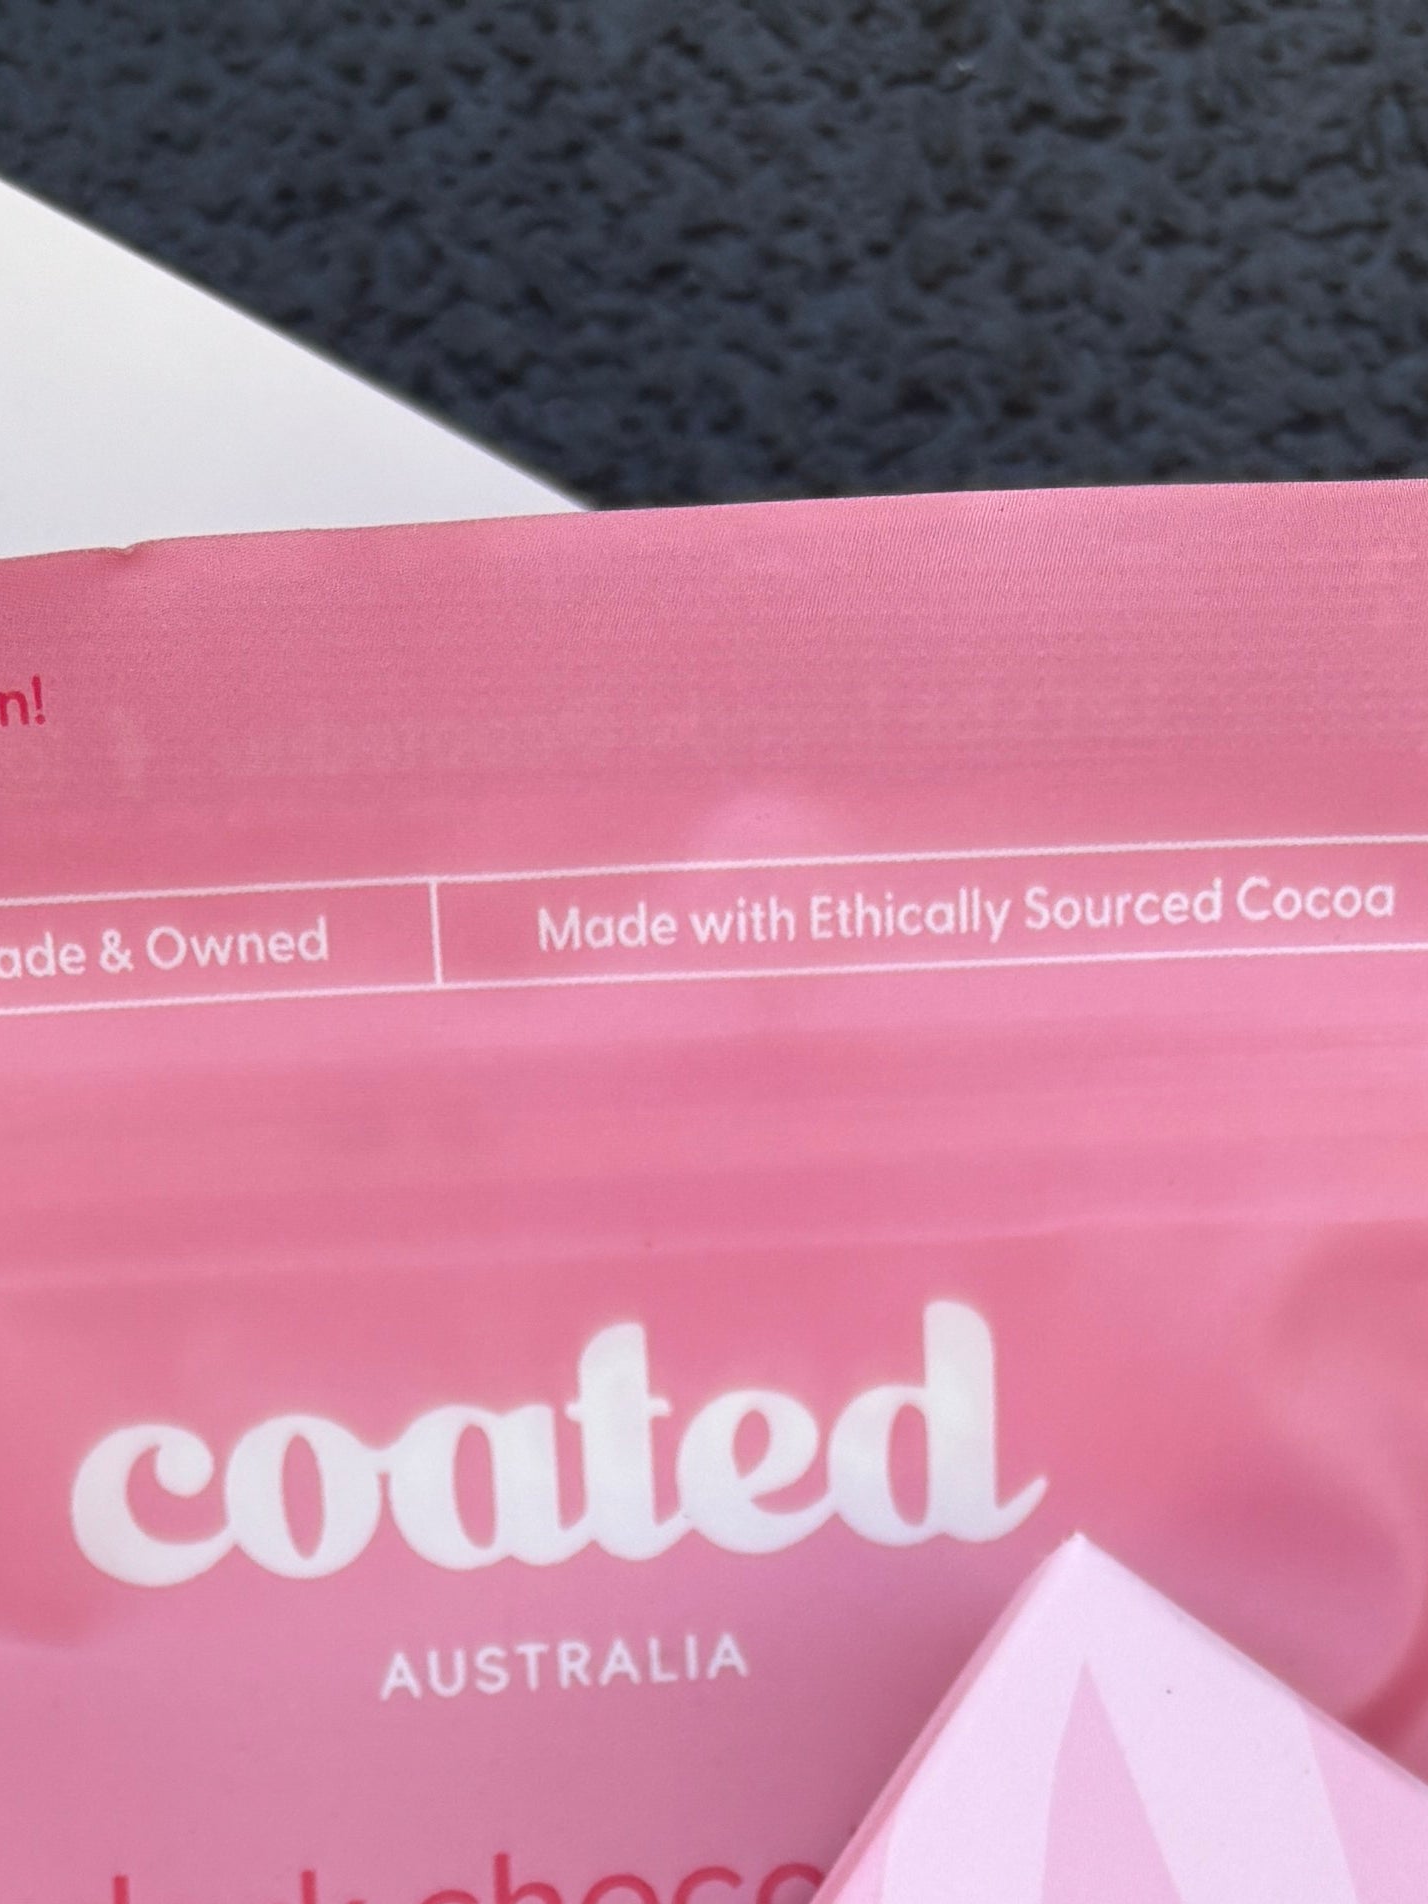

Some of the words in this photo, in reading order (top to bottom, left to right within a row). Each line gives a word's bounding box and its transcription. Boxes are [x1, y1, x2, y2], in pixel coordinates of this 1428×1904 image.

[100, 929, 133, 973] &
[146, 916, 330, 970] Owned
[537, 907, 679, 952] Made
[690, 896, 795, 944] with
[809, 886, 1012, 942] Ethically
[1024, 879, 1223, 931] Sourced
[1236, 875, 1396, 922] Cocoa
[70, 1300, 1048, 1588] coated
[380, 1632, 749, 1701] AUSTRALIA
